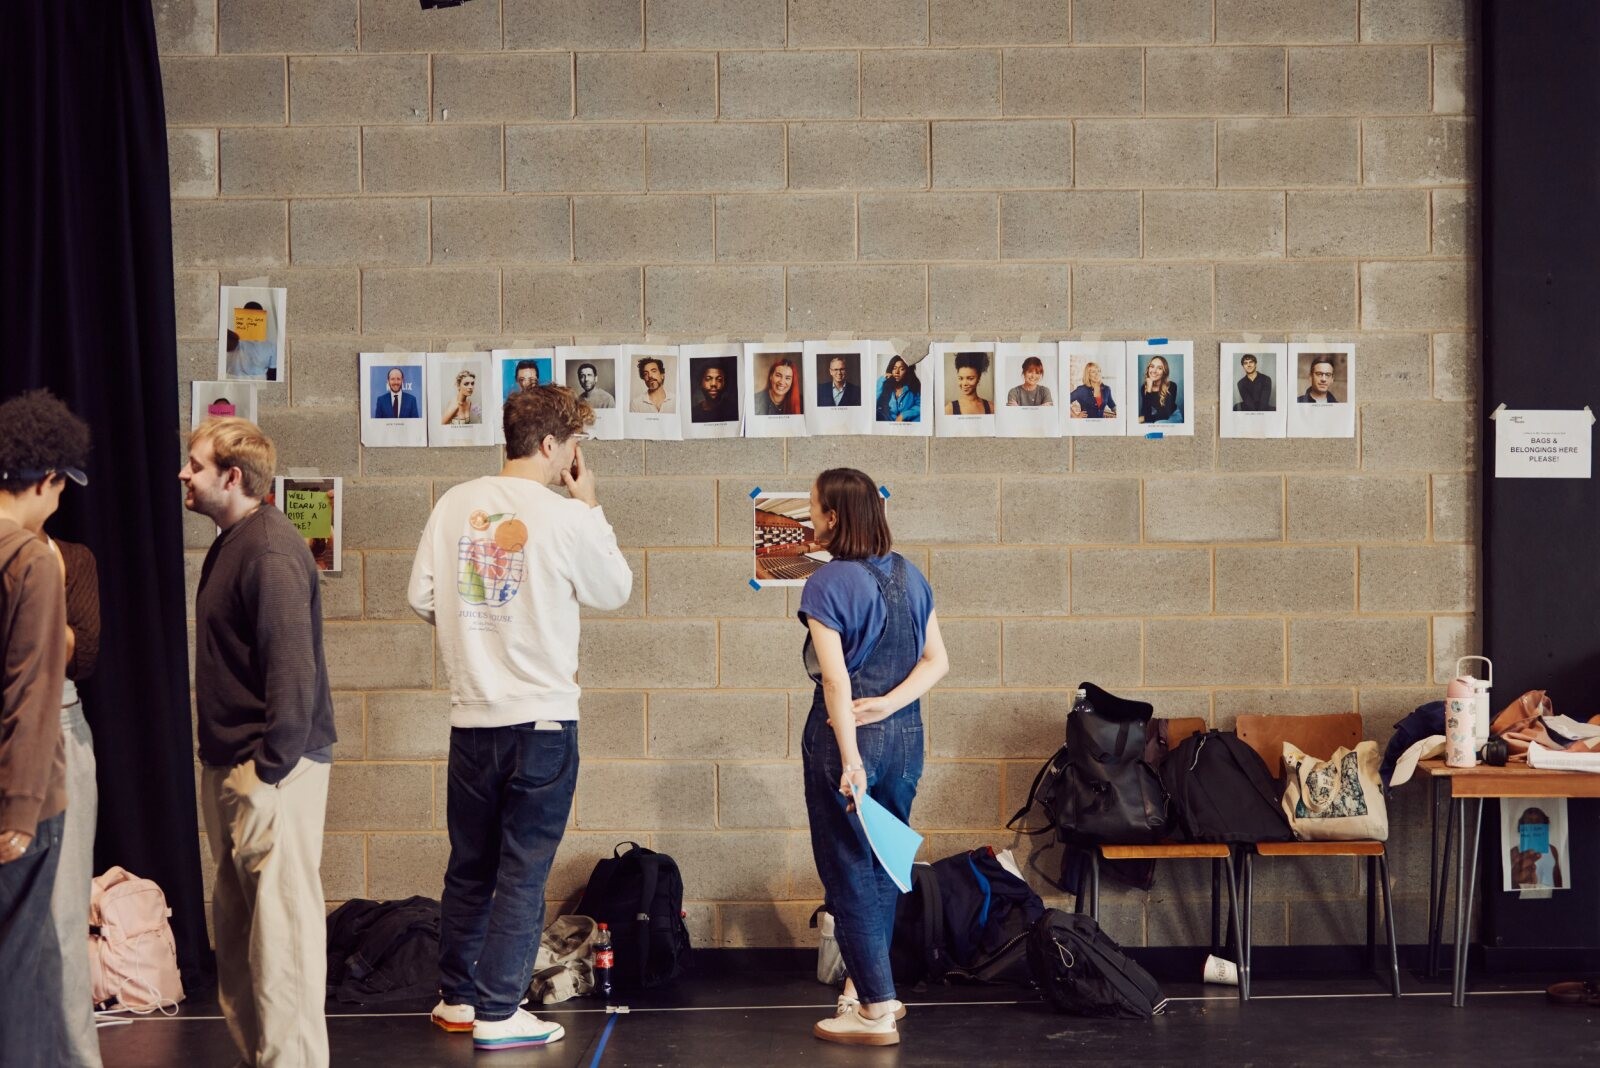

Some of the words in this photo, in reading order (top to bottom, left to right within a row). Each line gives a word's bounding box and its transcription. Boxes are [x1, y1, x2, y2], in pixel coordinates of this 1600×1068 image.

[386, 382, 412, 391] NLIX
[1529, 455, 1560, 463] PLEASE!
[289, 501, 315, 509] LEARN
